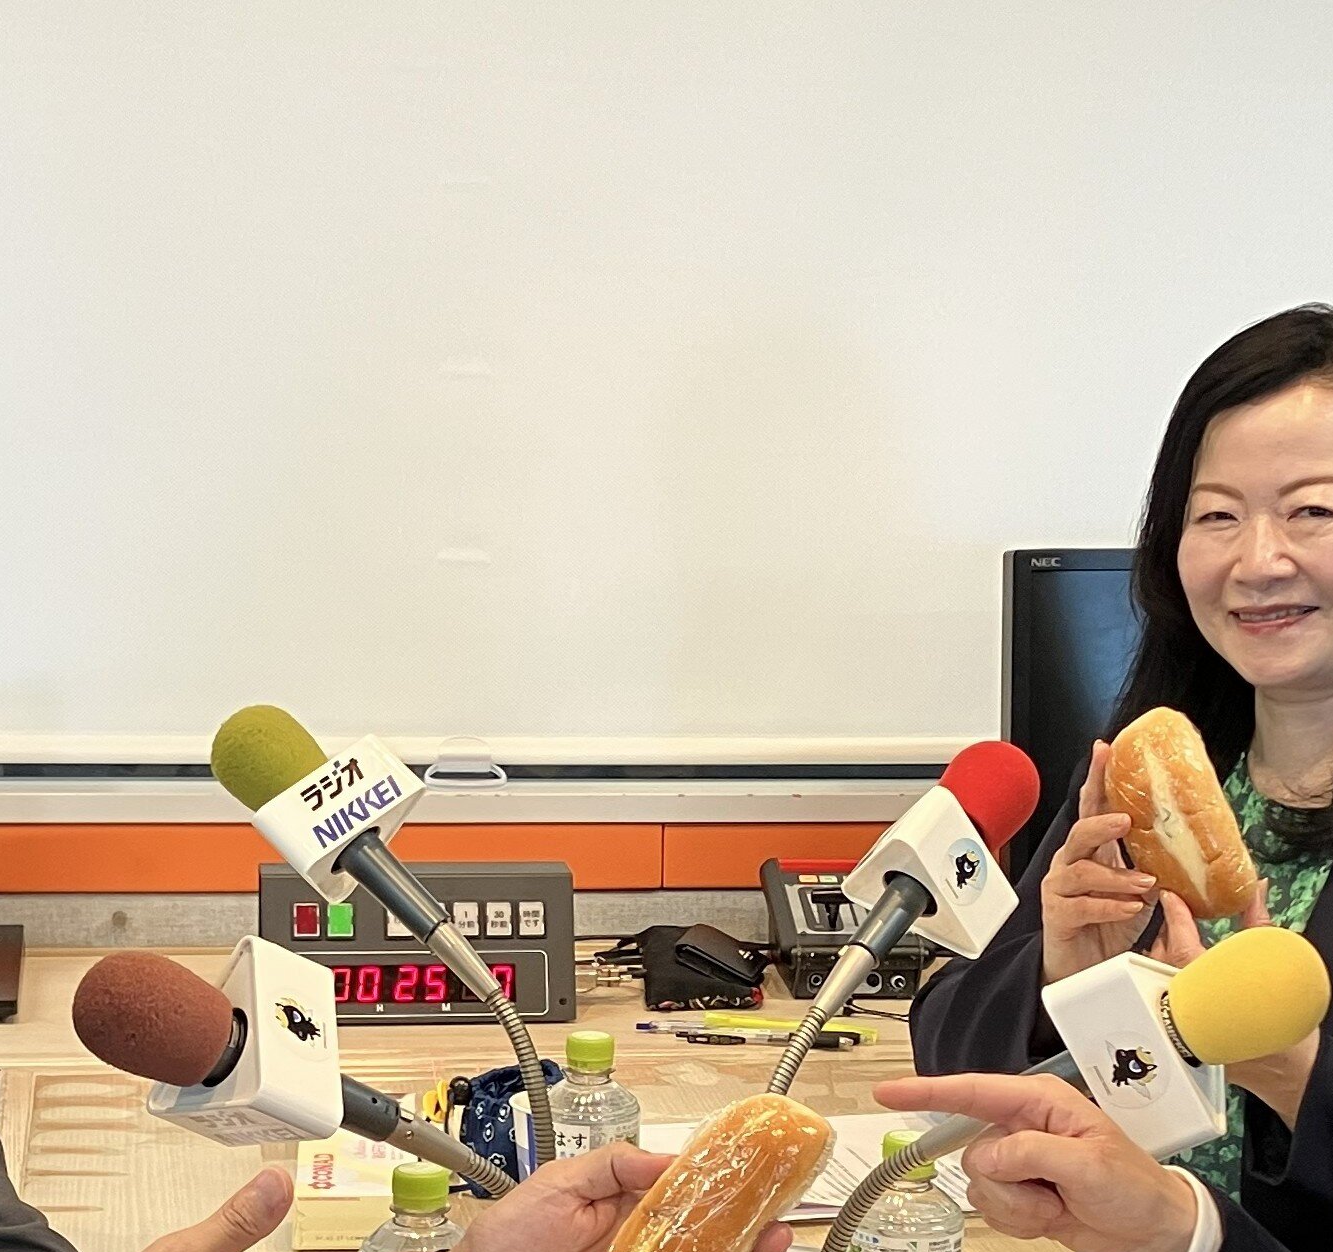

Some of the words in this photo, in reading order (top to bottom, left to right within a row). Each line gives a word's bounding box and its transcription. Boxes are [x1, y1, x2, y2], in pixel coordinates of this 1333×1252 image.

[1030, 556, 1062, 568] NEC
[300, 757, 364, 812] ラジオ
[312, 774, 403, 850] NIKKEI
[493, 910, 505, 919] 30
[524, 919, 540, 928] です
[393, 965, 447, 1002] 25
[376, 1003, 384, 1012] H
[441, 1003, 451, 1012] M
